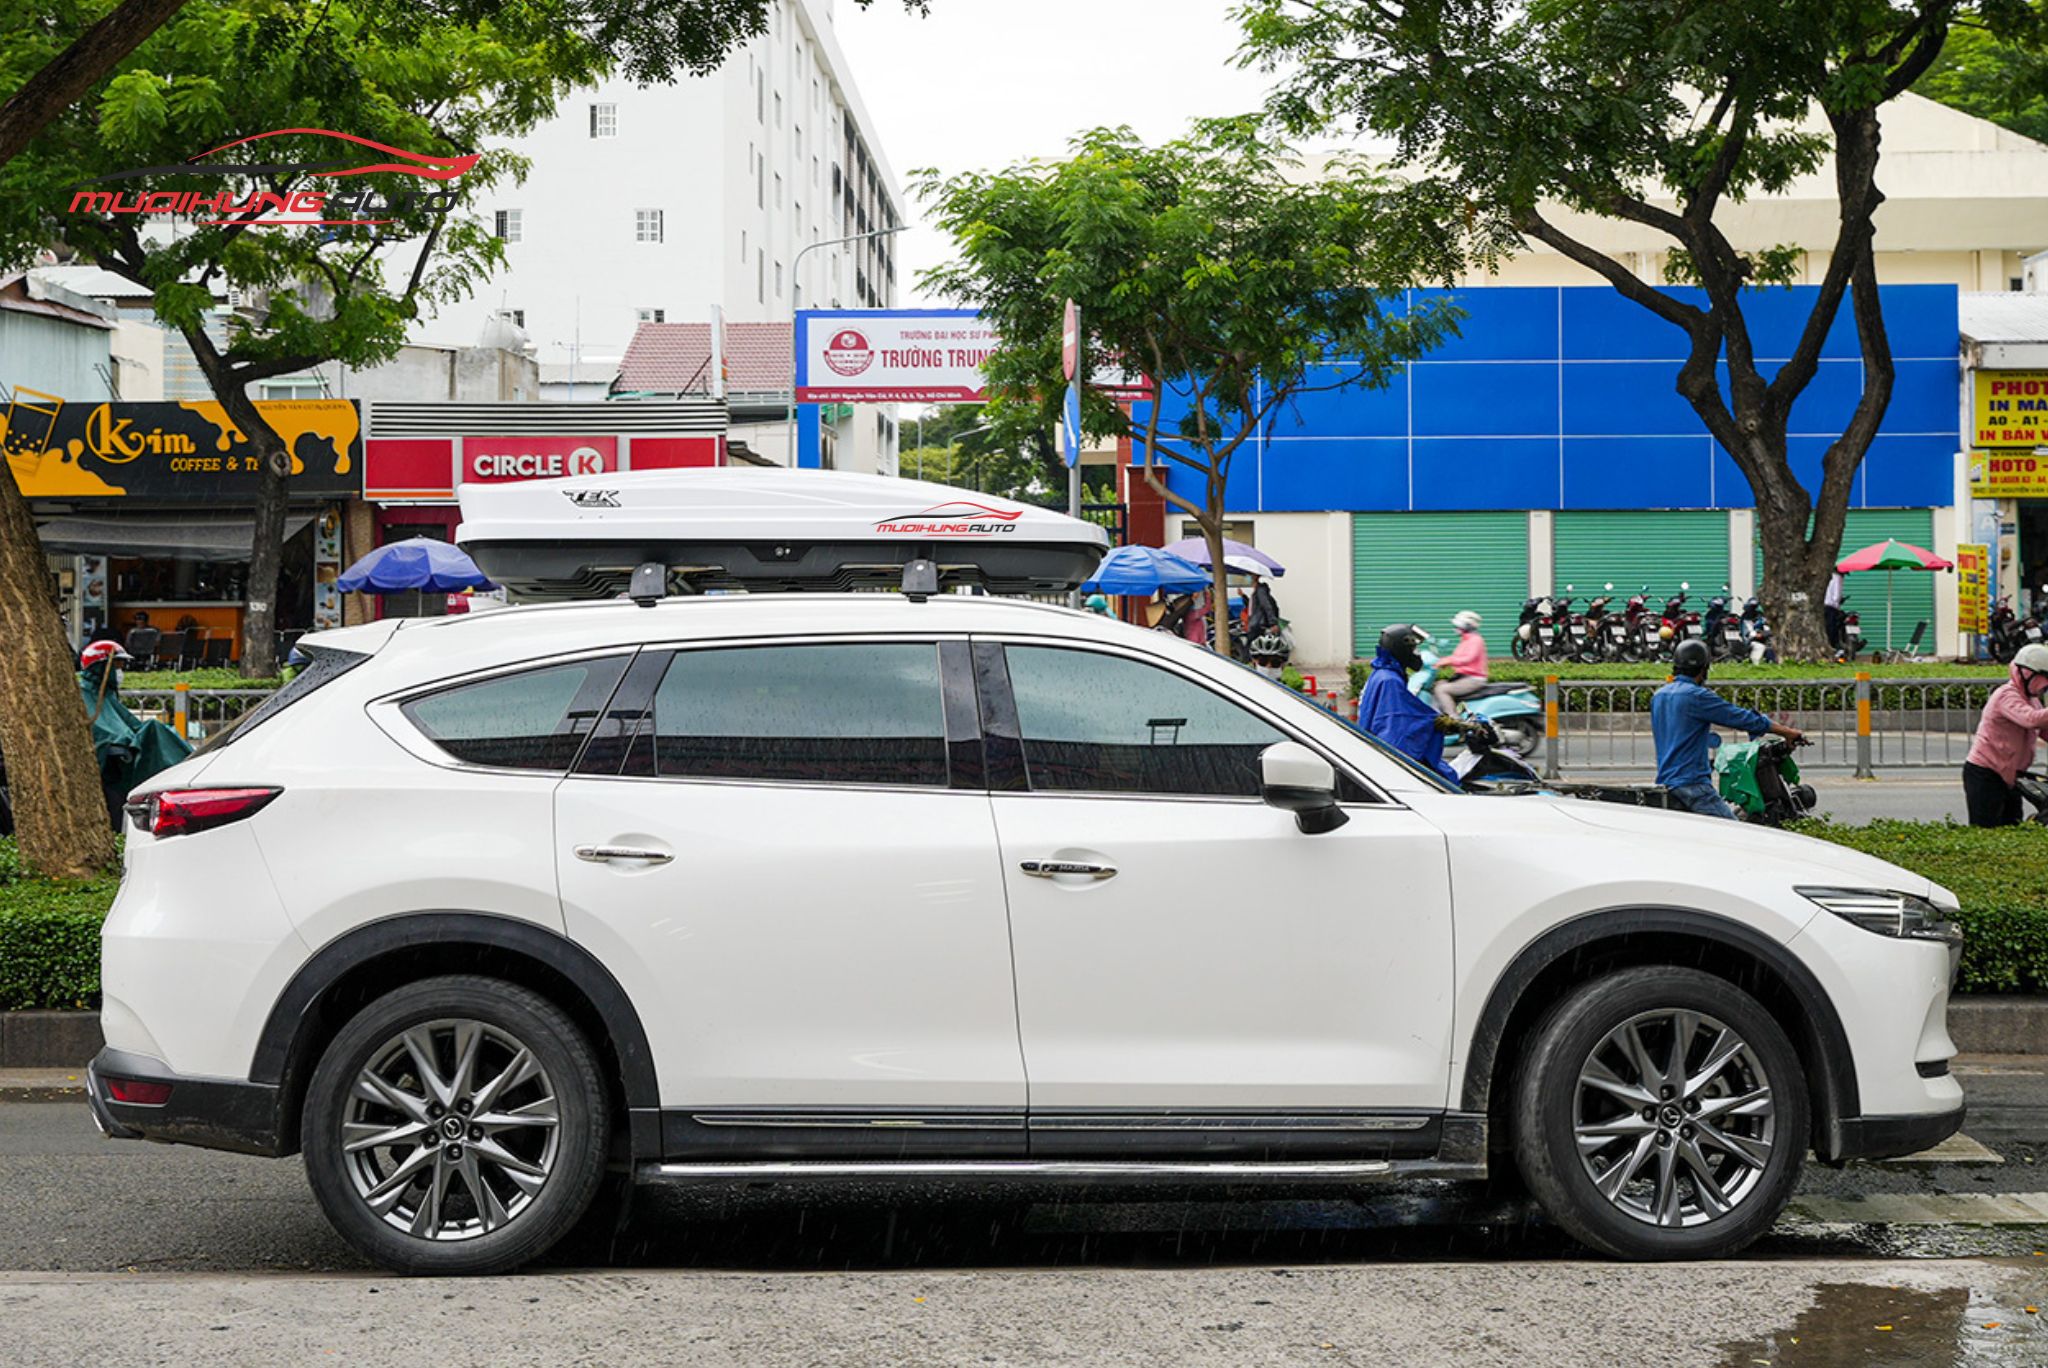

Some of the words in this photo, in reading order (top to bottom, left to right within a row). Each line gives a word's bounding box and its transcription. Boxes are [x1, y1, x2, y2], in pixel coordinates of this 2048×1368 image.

[881, 345, 942, 368] TRƯỜNG
[1990, 400, 2009, 411] IN
[2022, 416, 2038, 425] A1
[86, 402, 196, 464] Kim
[1980, 430, 1996, 440] IN
[170, 457, 221, 472] COFFEE
[226, 457, 239, 471] &
[473, 455, 562, 476] CIRCLE
[578, 455, 597, 474] K
[1990, 459, 2037, 472] HOTO
[562, 490, 621, 508] TEK
